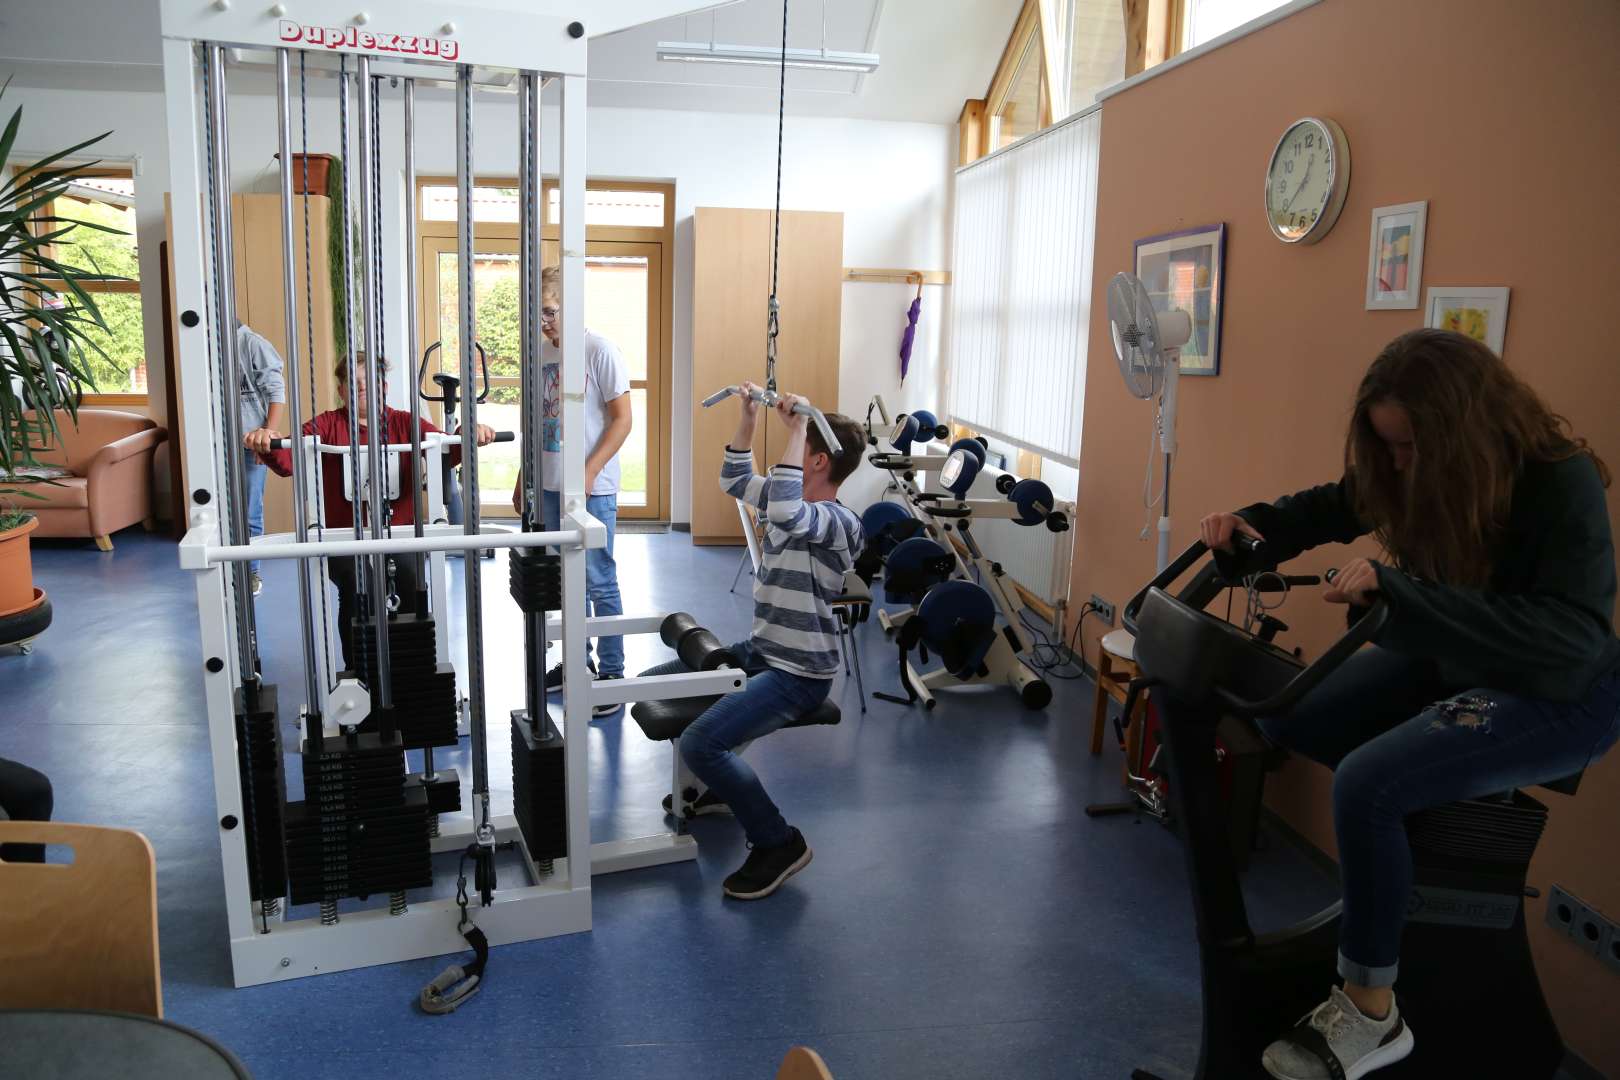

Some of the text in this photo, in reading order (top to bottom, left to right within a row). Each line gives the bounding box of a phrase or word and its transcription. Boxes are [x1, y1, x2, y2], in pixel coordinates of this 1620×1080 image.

[279, 19, 459, 60] Duplexzug
[1304, 133, 1314, 148] 12
[1318, 136, 1323, 149] 1
[1294, 143, 1301, 156] 11
[1284, 160, 1294, 174] 10
[1279, 180, 1287, 193] 9
[1282, 198, 1290, 213] 8
[1289, 213, 1296, 227] 7
[1299, 215, 1306, 228] 6
[1311, 208, 1317, 222] 5
